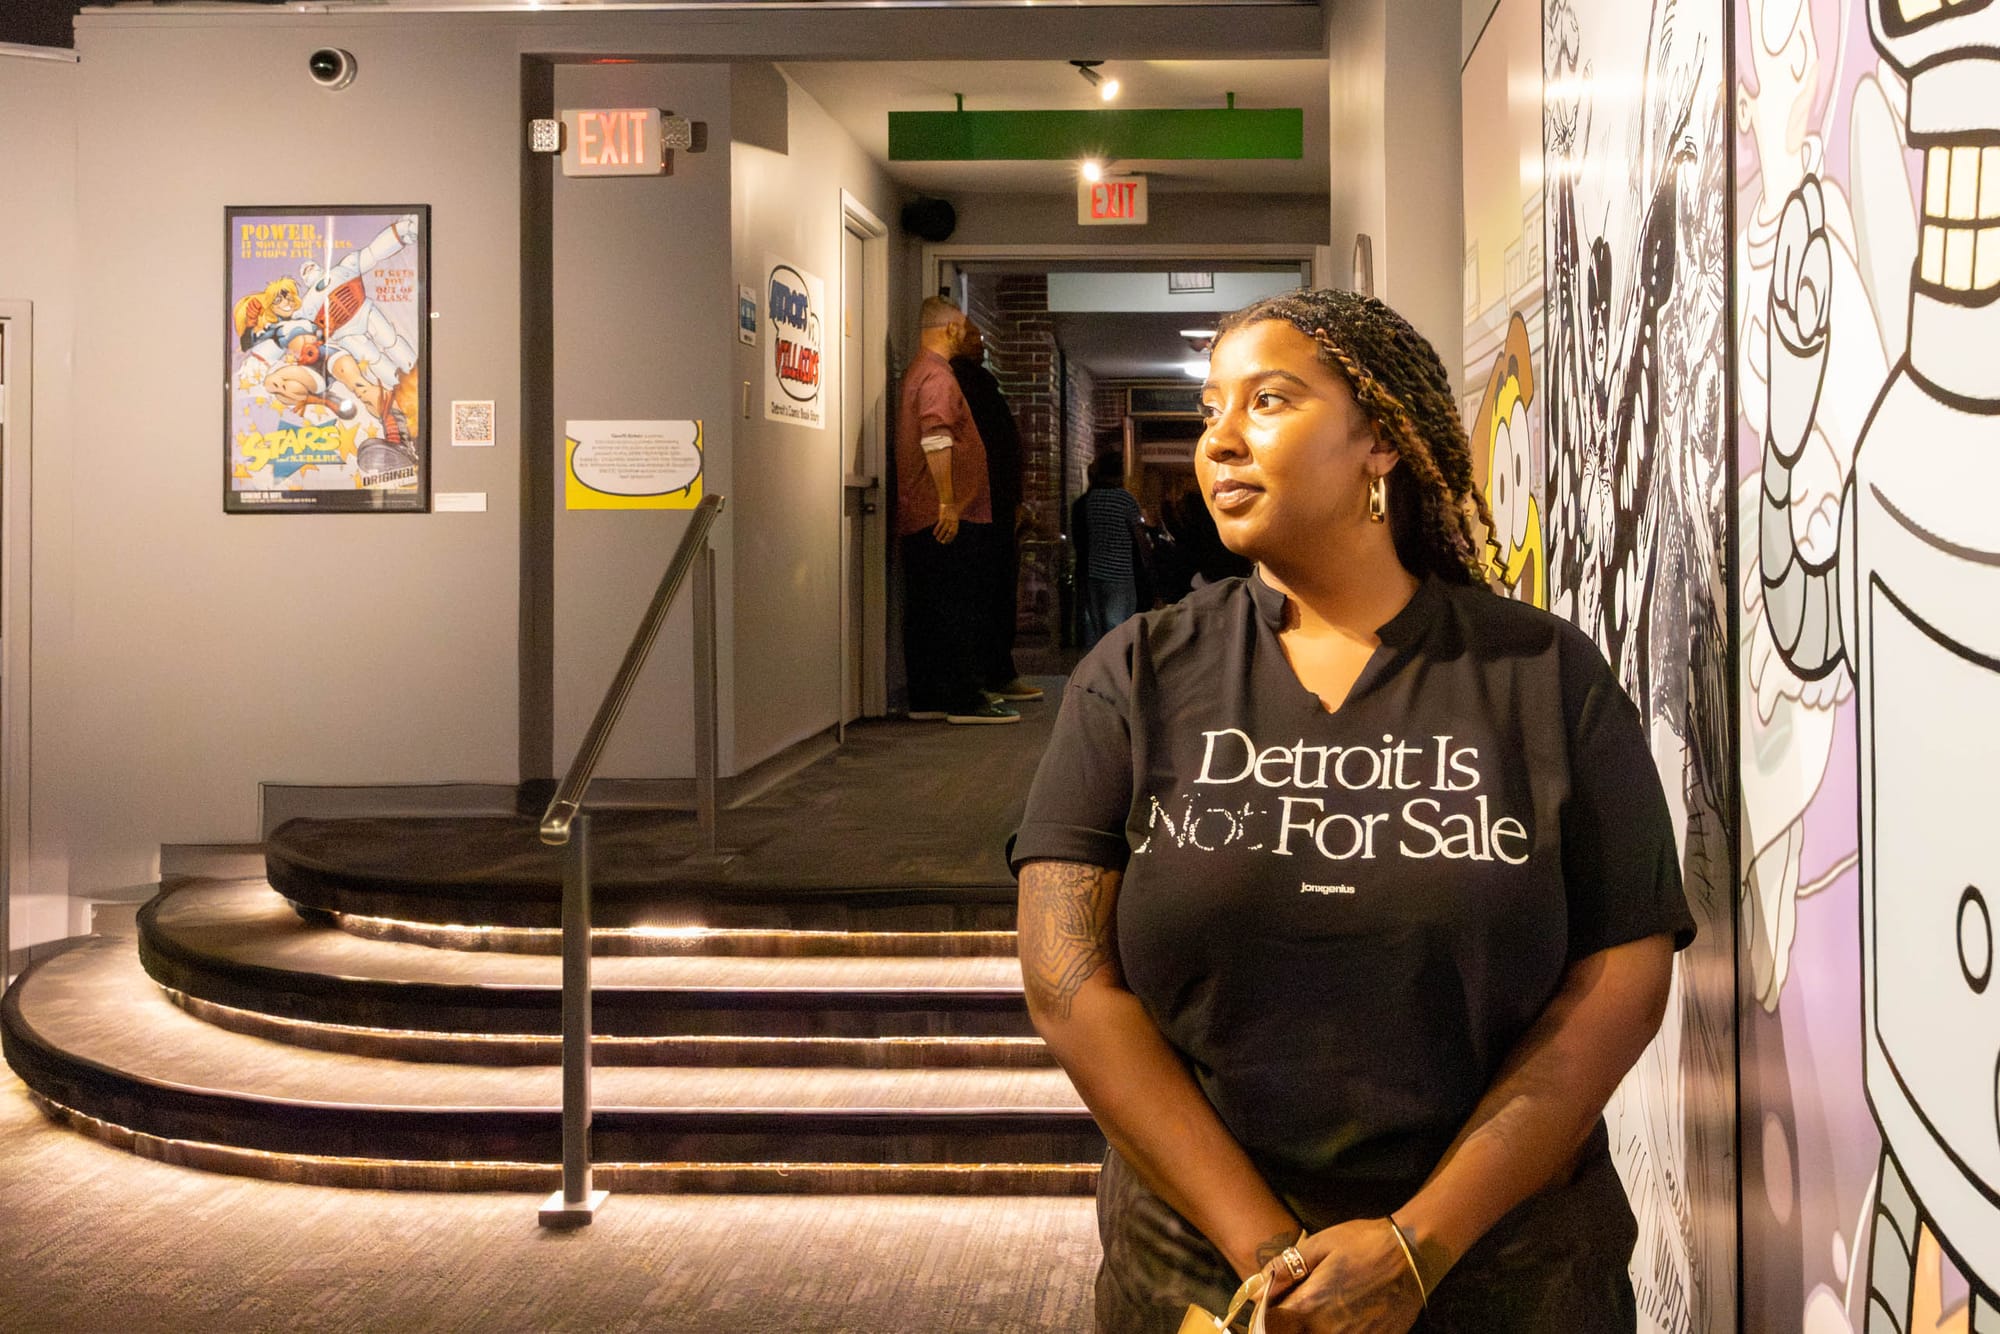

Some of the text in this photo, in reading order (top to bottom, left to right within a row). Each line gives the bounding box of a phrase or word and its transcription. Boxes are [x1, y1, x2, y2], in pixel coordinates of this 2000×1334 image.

[578, 112, 648, 165] EXIT
[1092, 183, 1138, 219] EXIT
[241, 223, 323, 241] POWER.
[241, 425, 342, 472] STARS
[1193, 728, 1480, 791] Detroit Is
[1134, 793, 1529, 865] Not For Sale
[1300, 881, 1356, 895] jonxgenius
